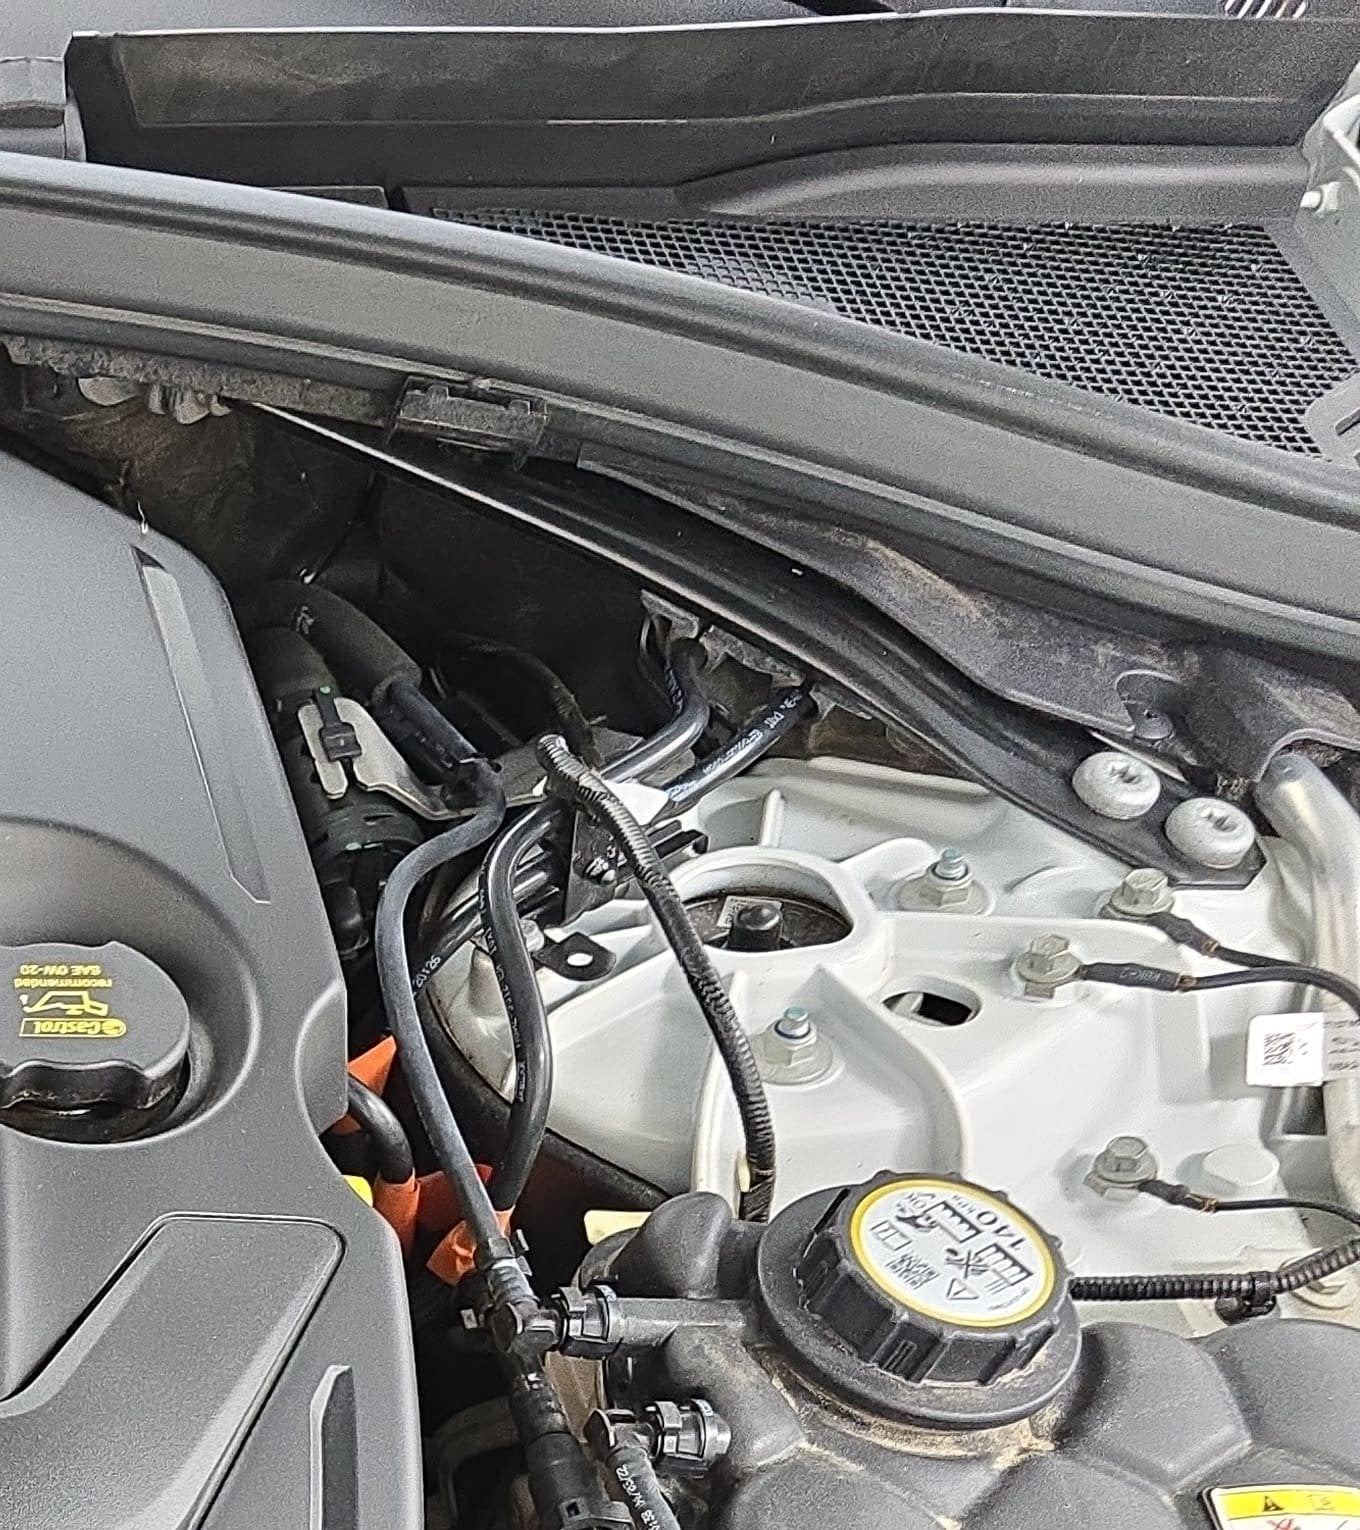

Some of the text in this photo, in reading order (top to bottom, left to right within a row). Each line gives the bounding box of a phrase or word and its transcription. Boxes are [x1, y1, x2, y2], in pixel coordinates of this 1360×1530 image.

[70, 965, 100, 975] SAE
[13, 978, 112, 988] recommended
[33, 1020, 100, 1034] Castrol
[977, 1210, 1026, 1250] 140
